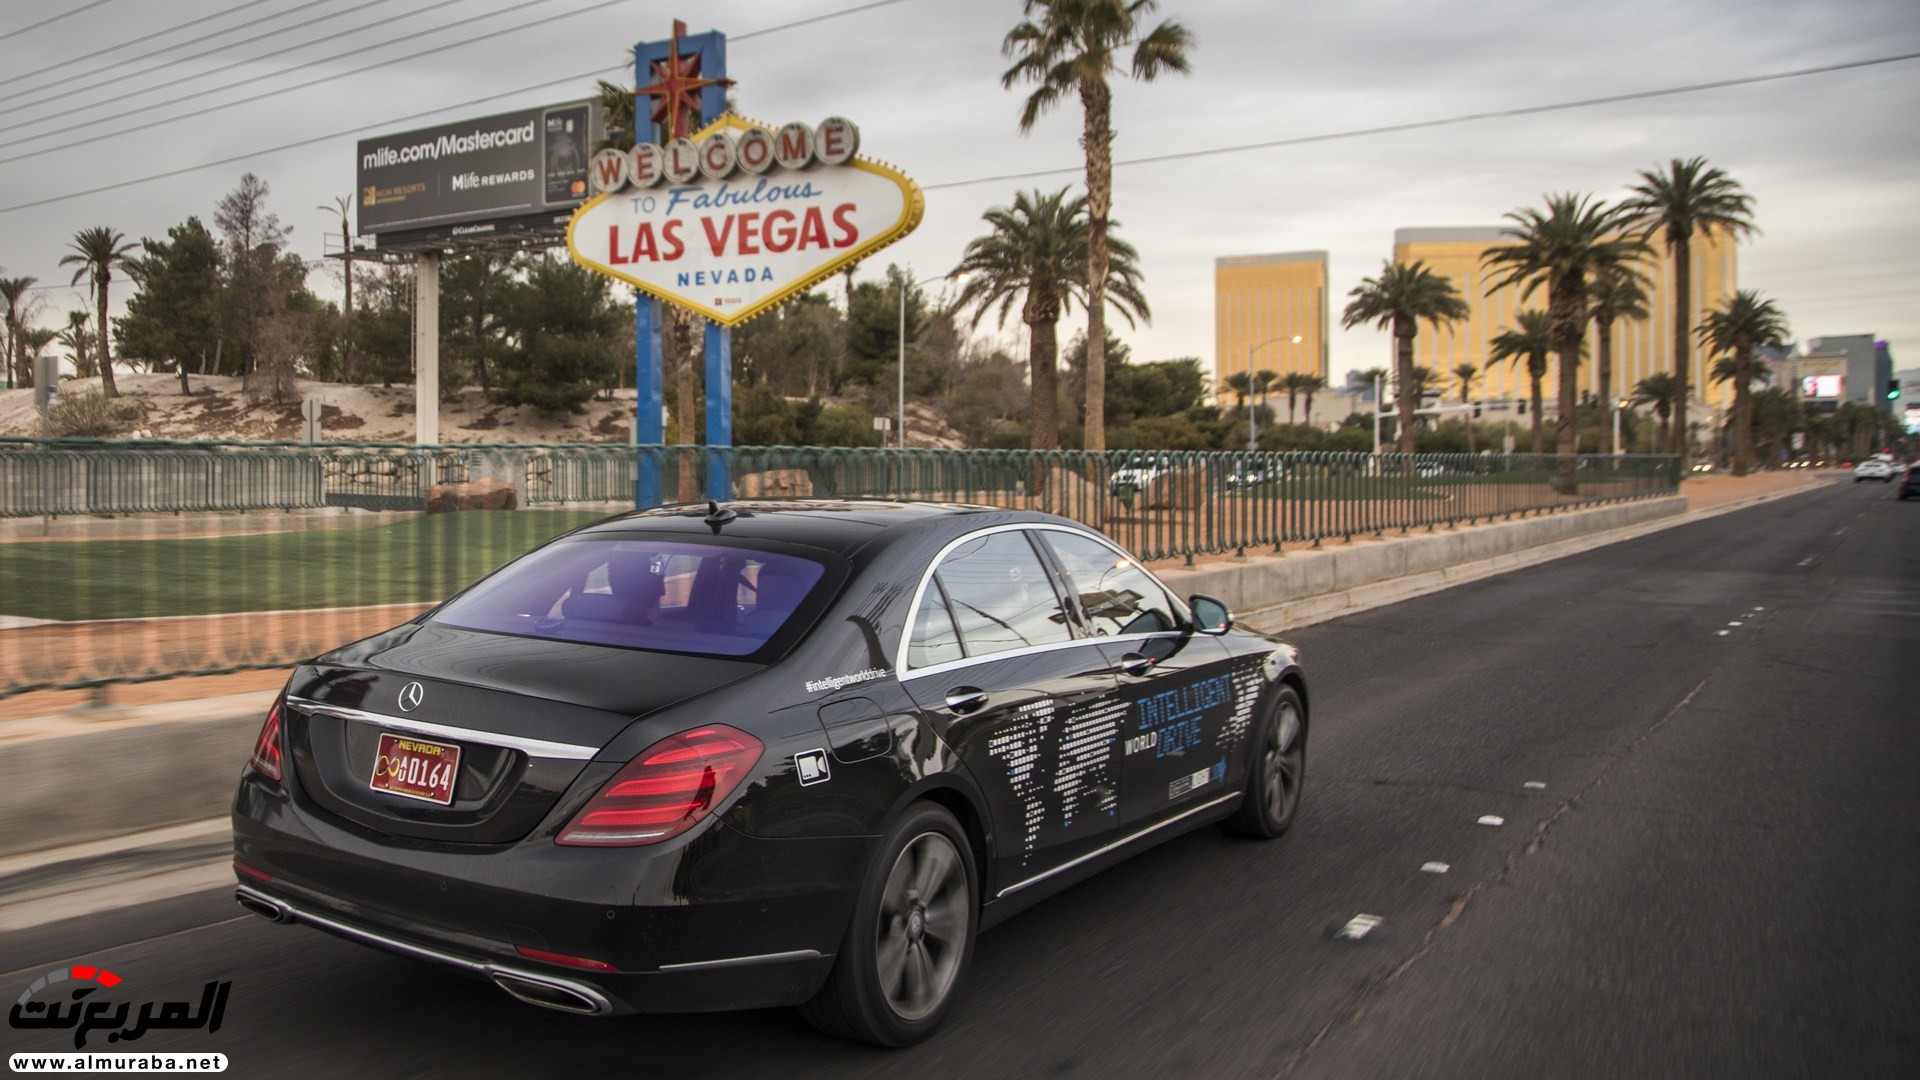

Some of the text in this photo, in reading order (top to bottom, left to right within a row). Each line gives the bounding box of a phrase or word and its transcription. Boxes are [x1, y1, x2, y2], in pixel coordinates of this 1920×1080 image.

[363, 120, 535, 170] mlife.com/Mastercard
[599, 126, 844, 188] WELCOME
[481, 169, 535, 186] REWARDS
[631, 178, 823, 216] TO Fabulous
[608, 203, 859, 265] LAS VEGAS
[677, 266, 774, 287] NEVADA
[805, 667, 887, 693] #intelligentworlddrive
[1137, 674, 1230, 730] INTELLIGENT
[398, 739, 441, 756] NEVADA
[1125, 715, 1202, 758] WORLD DRIVE
